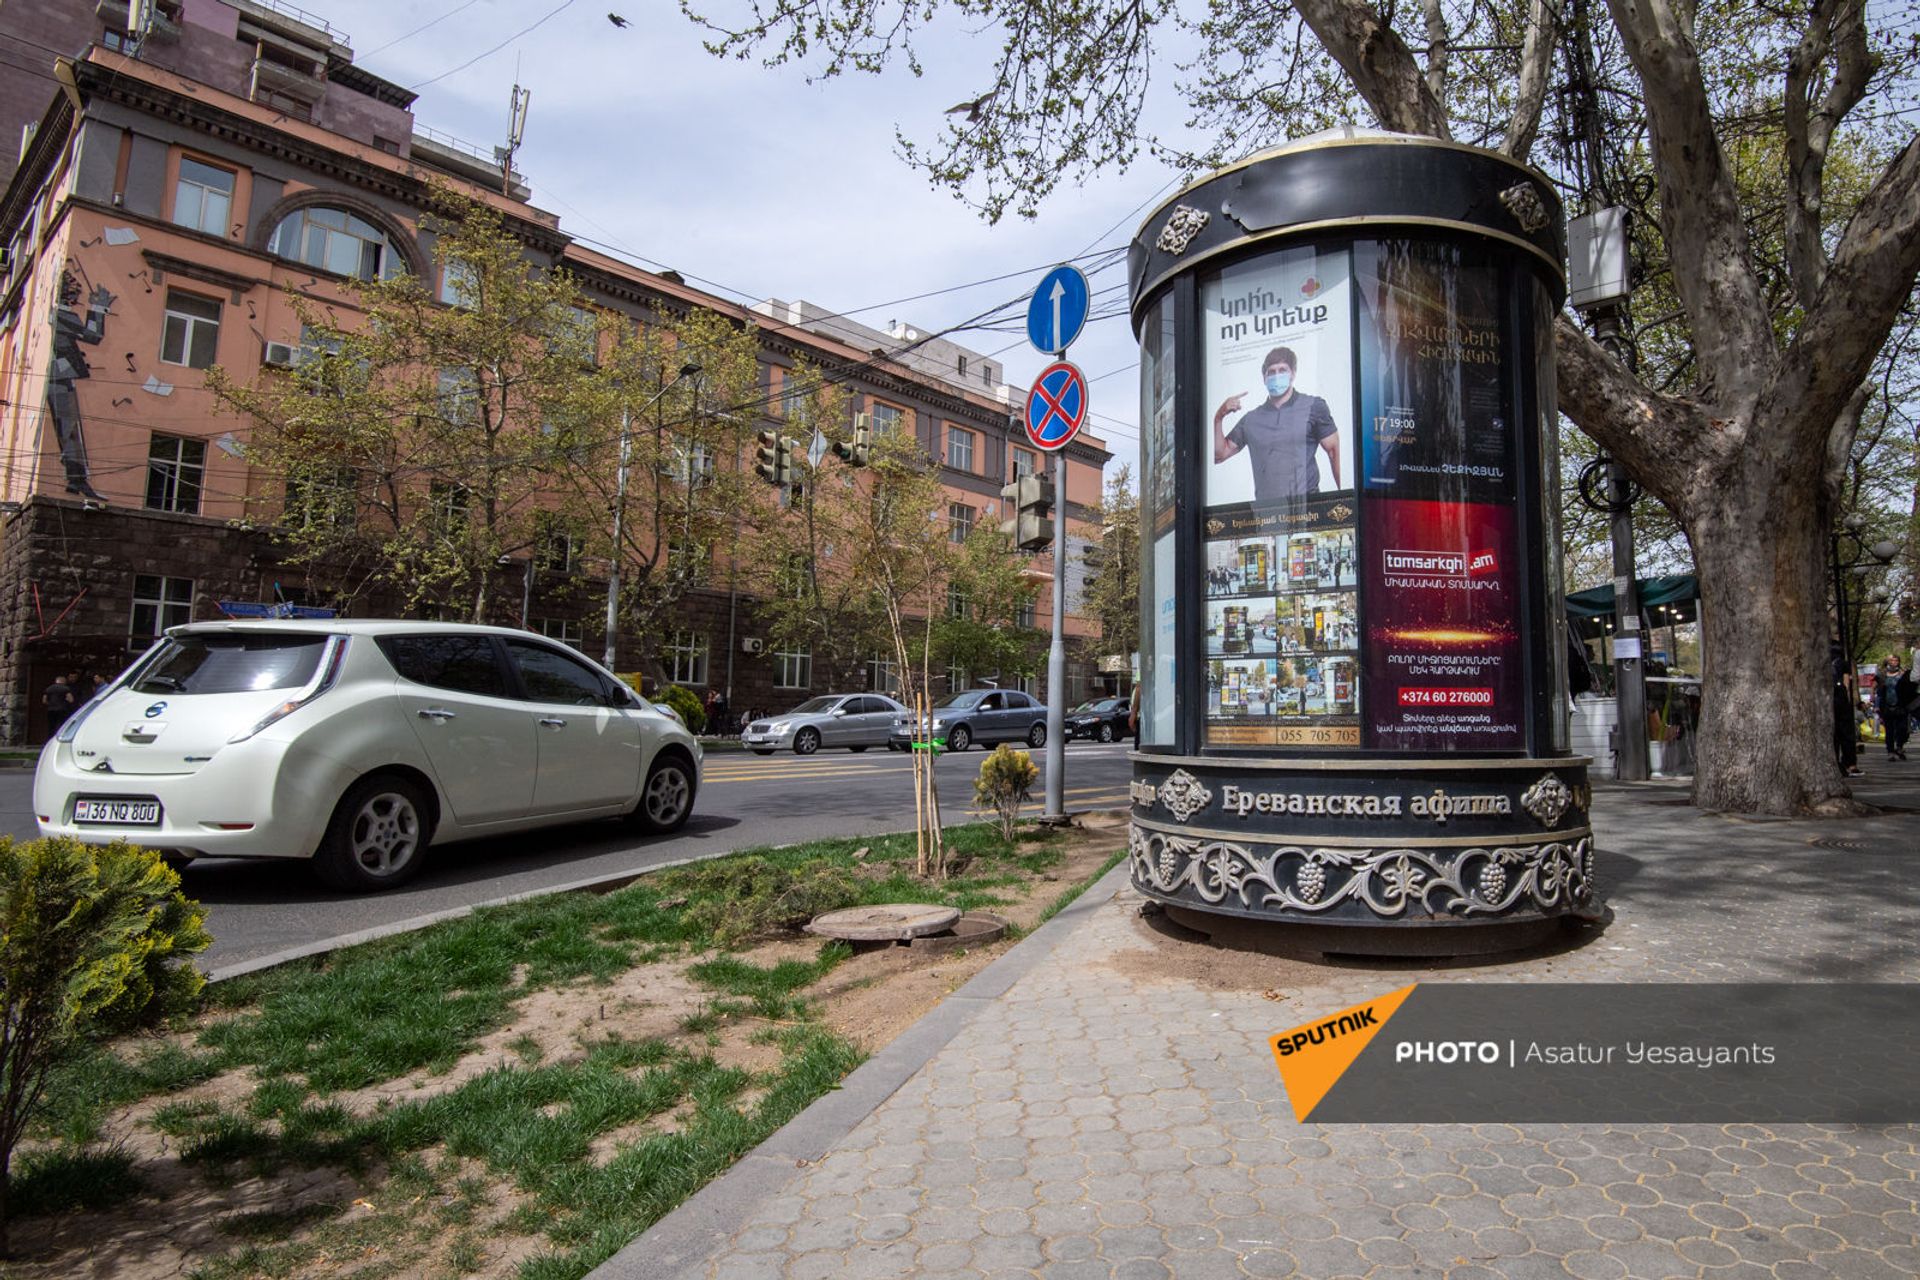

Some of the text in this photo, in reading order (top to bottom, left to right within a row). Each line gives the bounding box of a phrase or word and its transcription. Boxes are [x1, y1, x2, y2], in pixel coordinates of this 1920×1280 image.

[1221, 322, 1247, 341] որ
[1254, 304, 1328, 335] կրենք
[1373, 416, 1415, 432] 17 19:00
[1387, 554, 1494, 573] tomsarkgh .am
[1384, 577, 1446, 589] ՄԻԱՍՆԱԿԱՆ
[1388, 654, 1416, 664] ԲՈԼՈՐ
[1409, 666, 1428, 675] ՄԵԿ
[1401, 691, 1491, 703] +374 60 276000
[1280, 729, 1302, 741] 055
[1311, 729, 1331, 741] 705
[1336, 729, 1357, 741] 705
[1222, 785, 1512, 821] Ереванская афиша
[92, 803, 155, 821] 36 NQ 800
